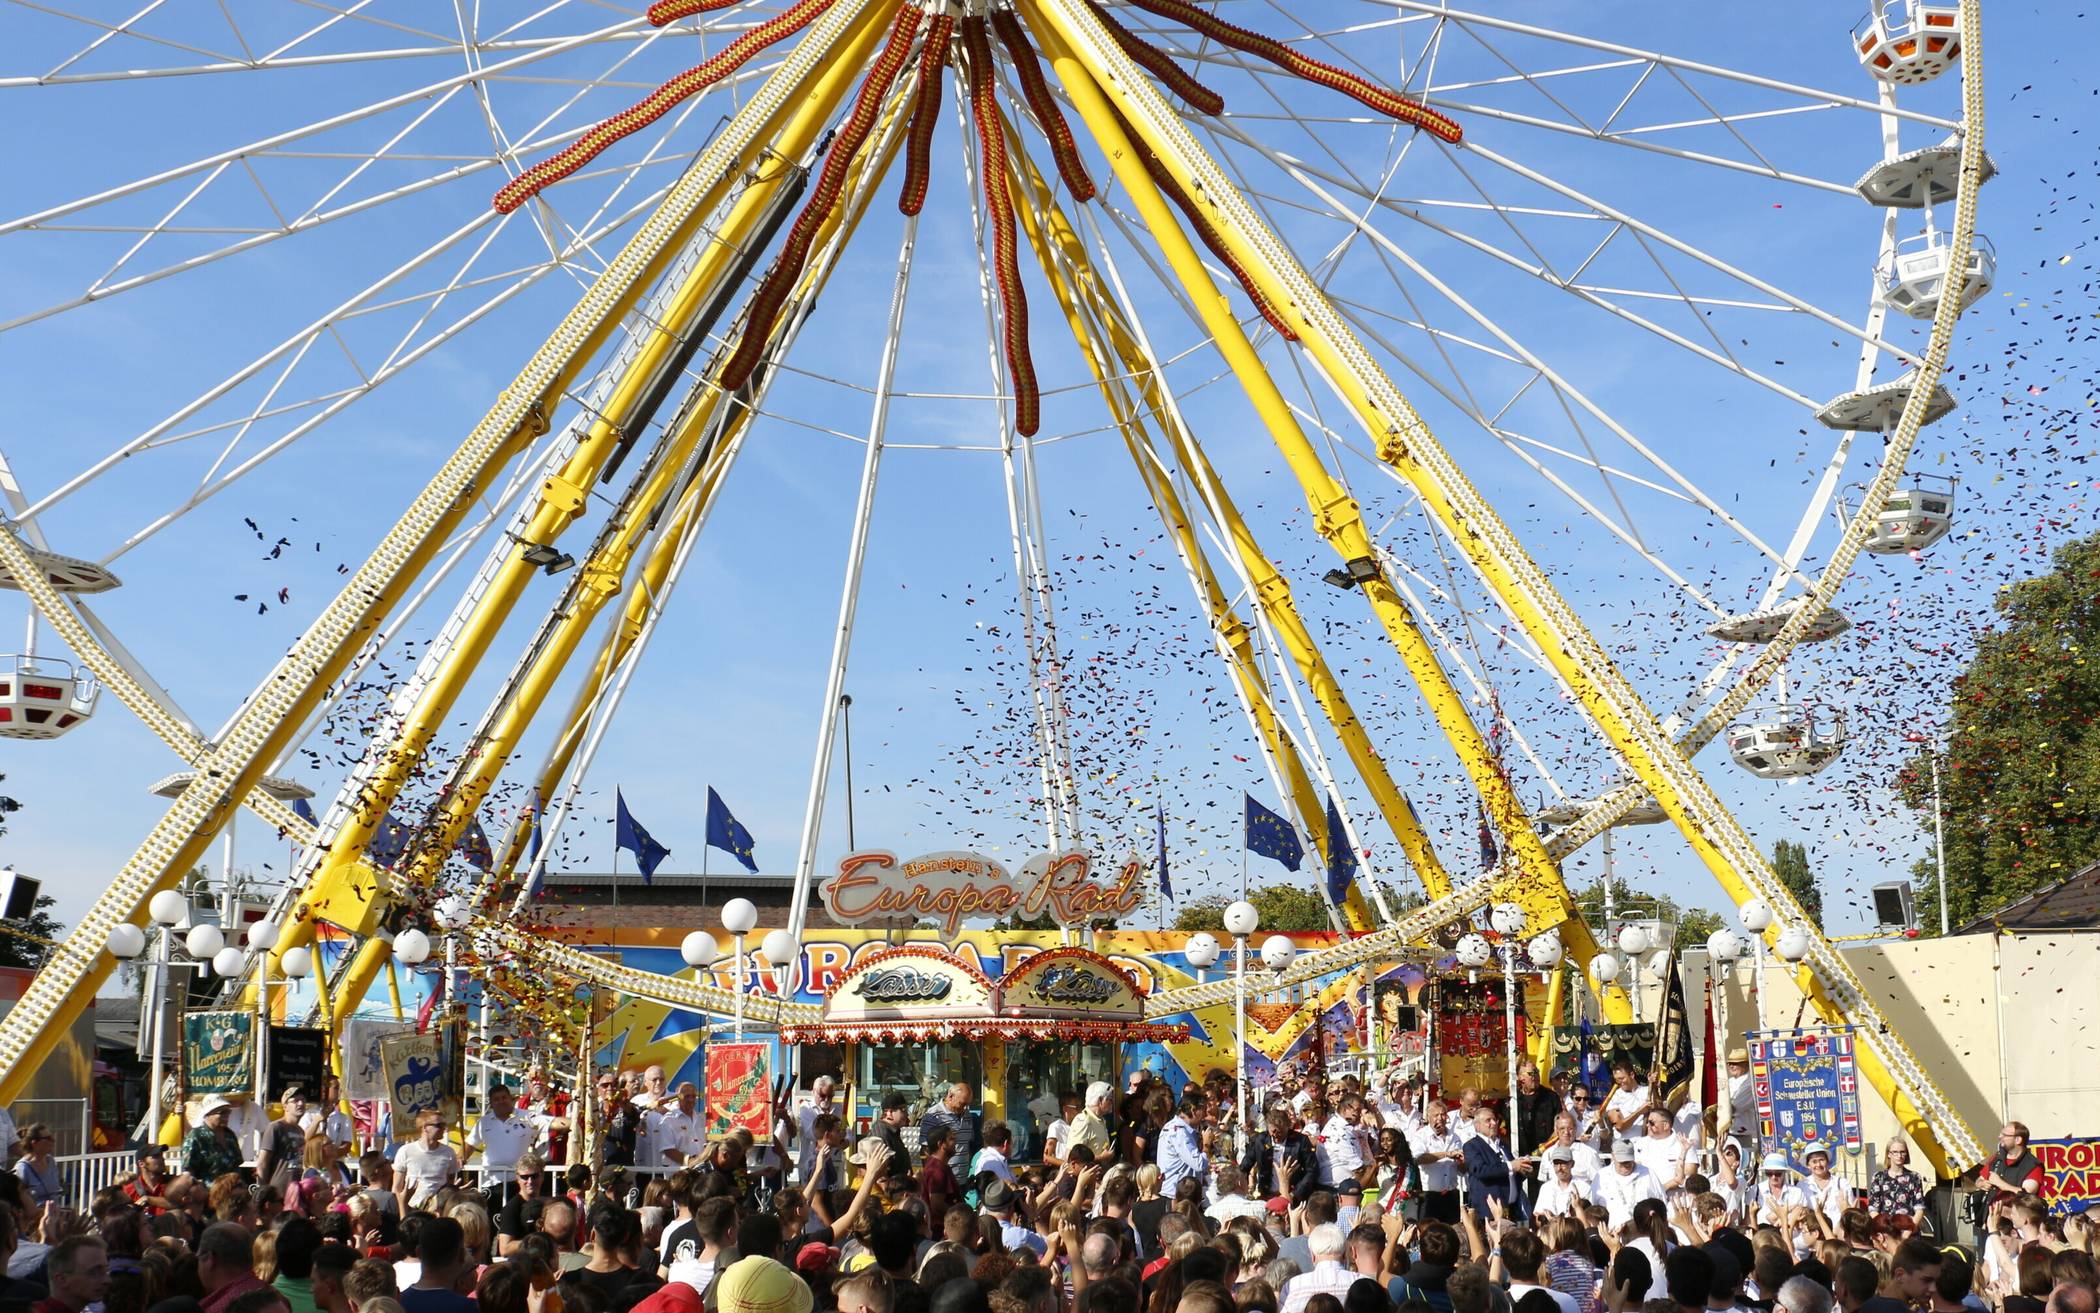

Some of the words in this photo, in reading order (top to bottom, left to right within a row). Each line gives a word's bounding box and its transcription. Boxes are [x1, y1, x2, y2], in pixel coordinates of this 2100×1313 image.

[826, 853, 1020, 939] Europa
[1027, 852, 1143, 923] Rad
[709, 941, 983, 995] EUR
[1783, 1077, 1825, 1090] Europäische
[1816, 1088, 1836, 1098] Union
[2033, 1144, 2100, 1170] RO
